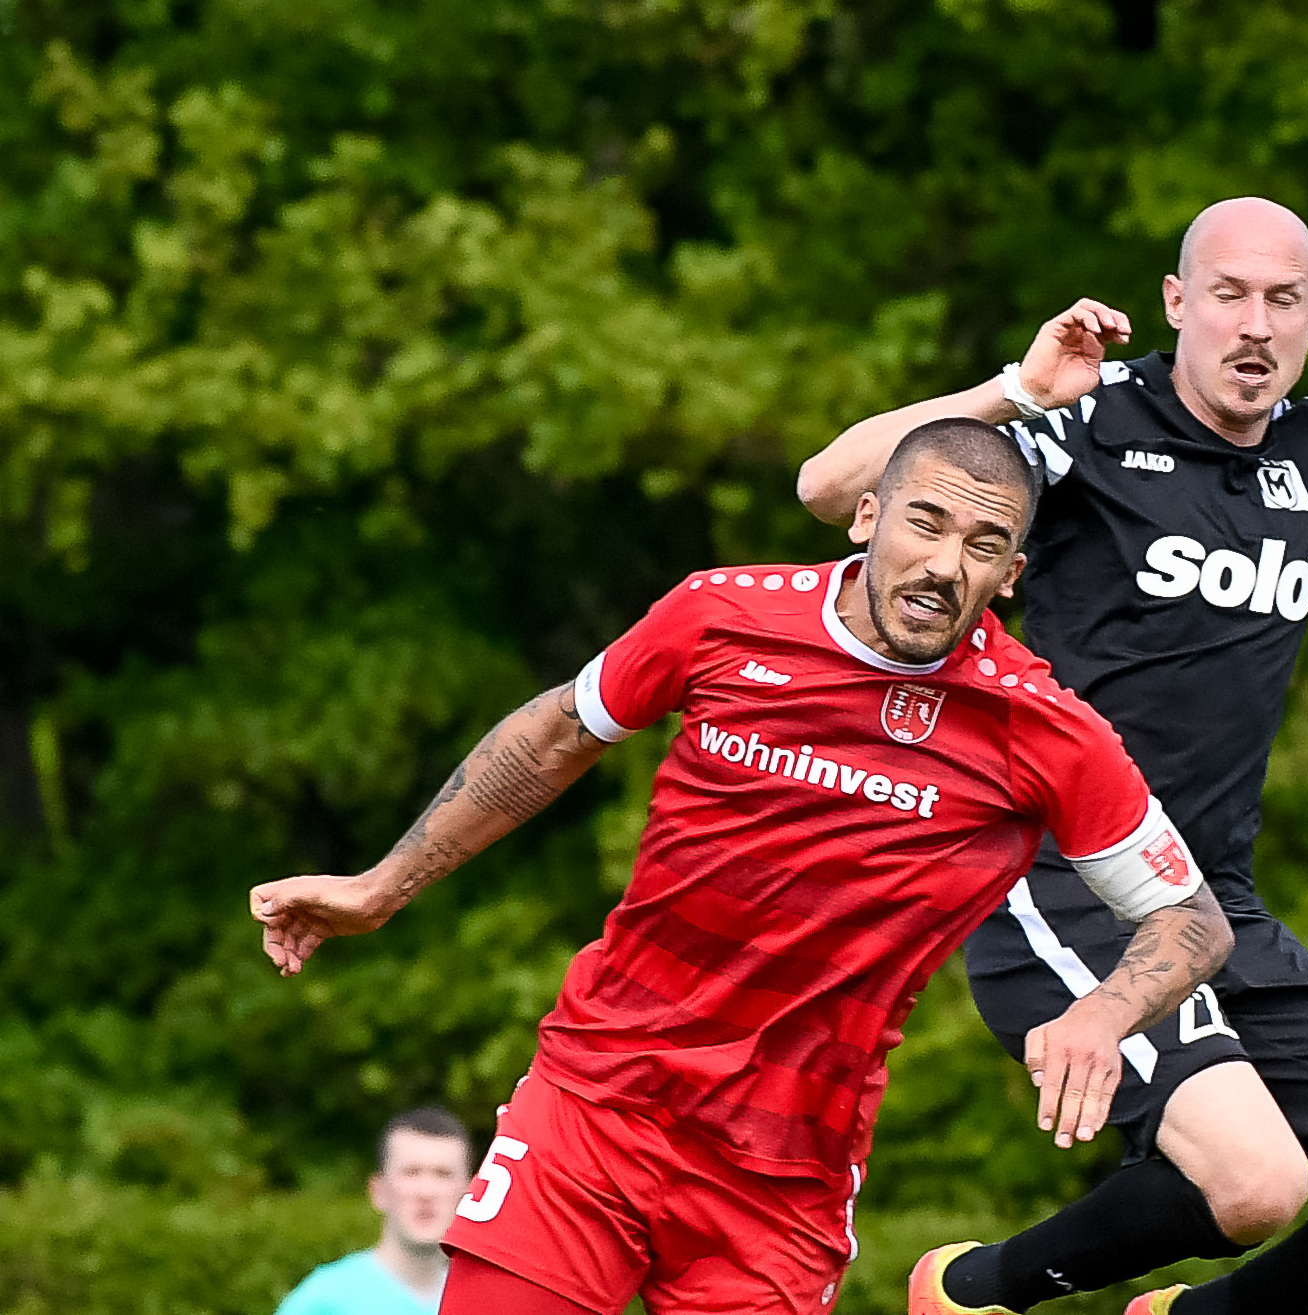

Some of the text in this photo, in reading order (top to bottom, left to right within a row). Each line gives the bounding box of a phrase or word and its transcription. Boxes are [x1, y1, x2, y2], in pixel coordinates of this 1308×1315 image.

[1121, 450, 1175, 473] JAKO
[700, 722, 940, 818] wohninvest
[456, 1135, 529, 1222] 5
